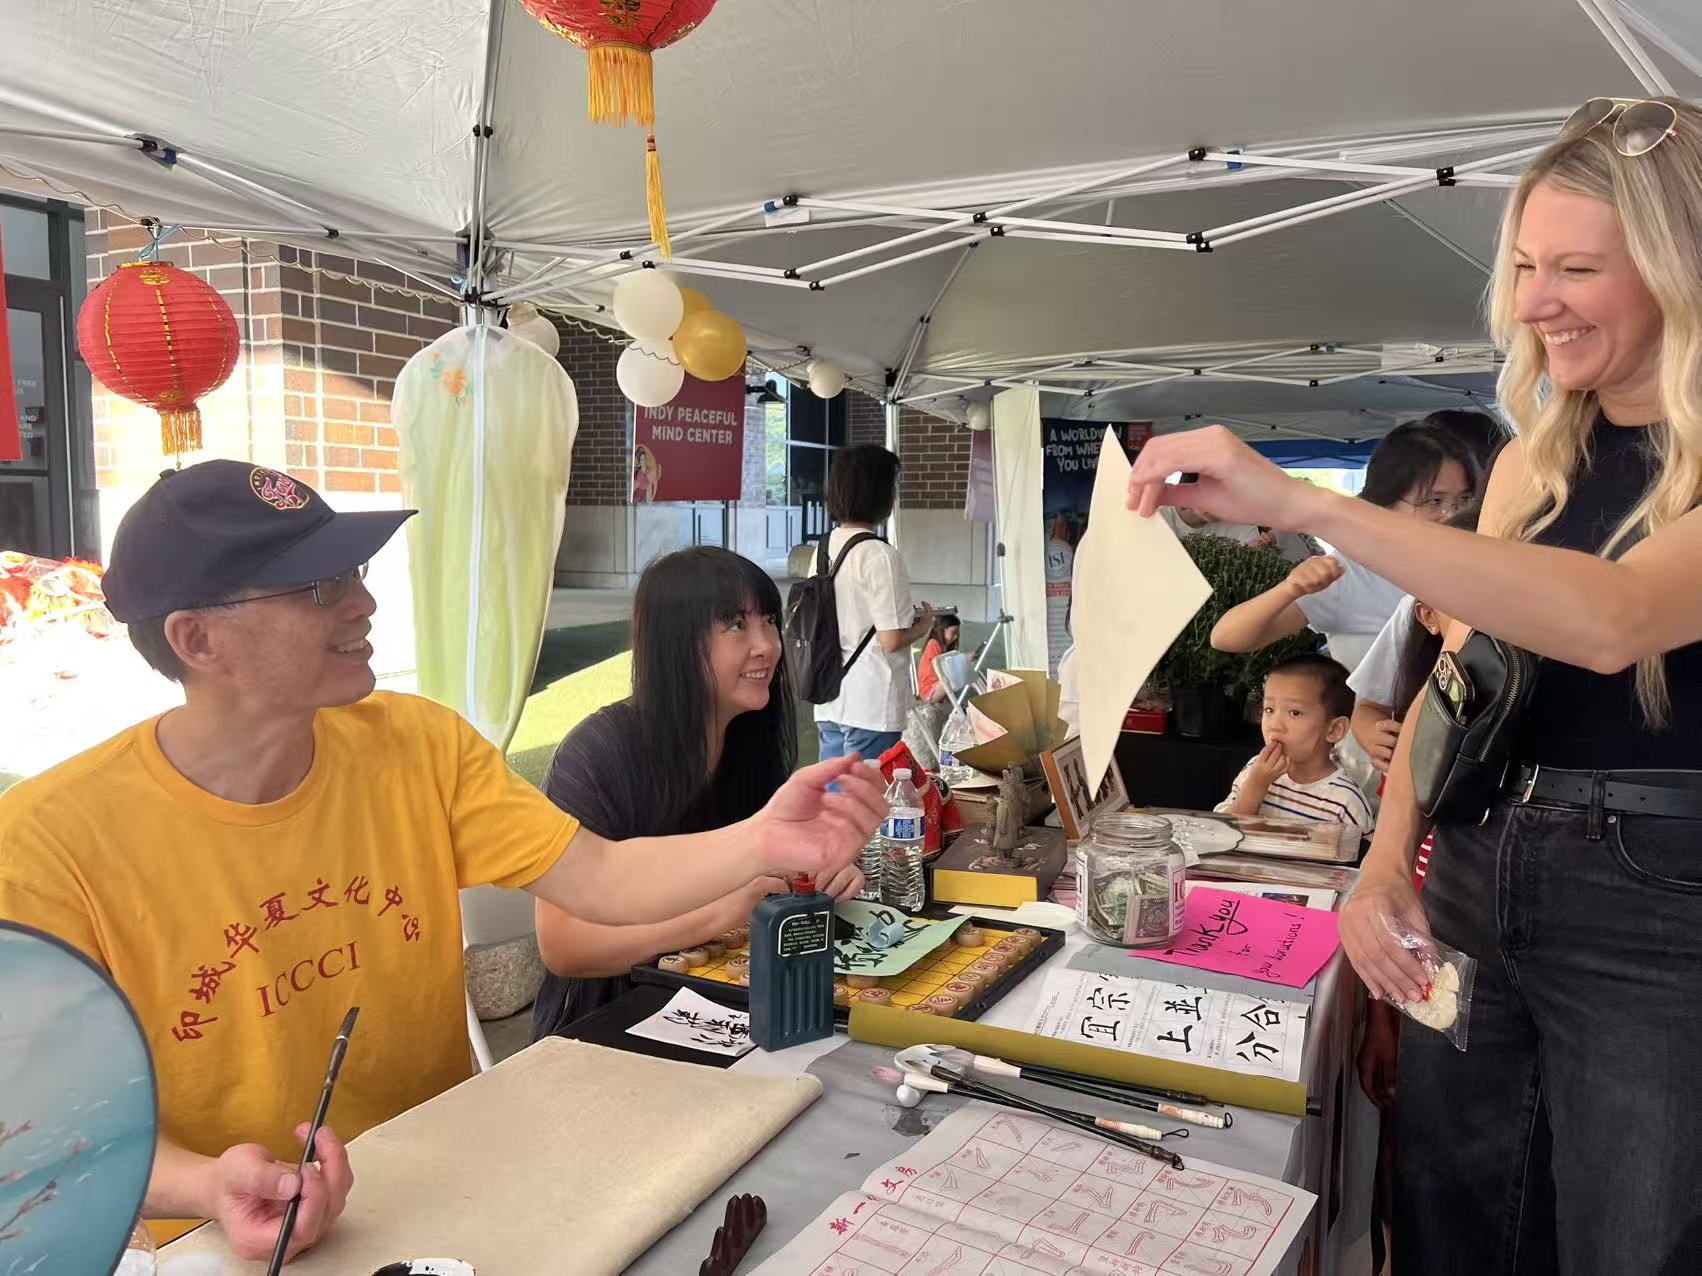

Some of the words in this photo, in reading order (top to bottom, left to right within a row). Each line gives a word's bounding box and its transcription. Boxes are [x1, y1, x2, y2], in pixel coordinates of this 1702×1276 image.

[644, 406, 674, 421] INDY
[678, 407, 738, 426] PEACEFUL
[652, 425, 684, 441] MIND
[687, 428, 733, 444] CENTER
[1050, 428, 1057, 442] A
[1046, 444, 1073, 457] FROM
[1076, 442, 1101, 456] WHE
[1057, 458, 1078, 472] YOU
[1082, 459, 1099, 470] LIV
[256, 940, 361, 1018] ICCCI
